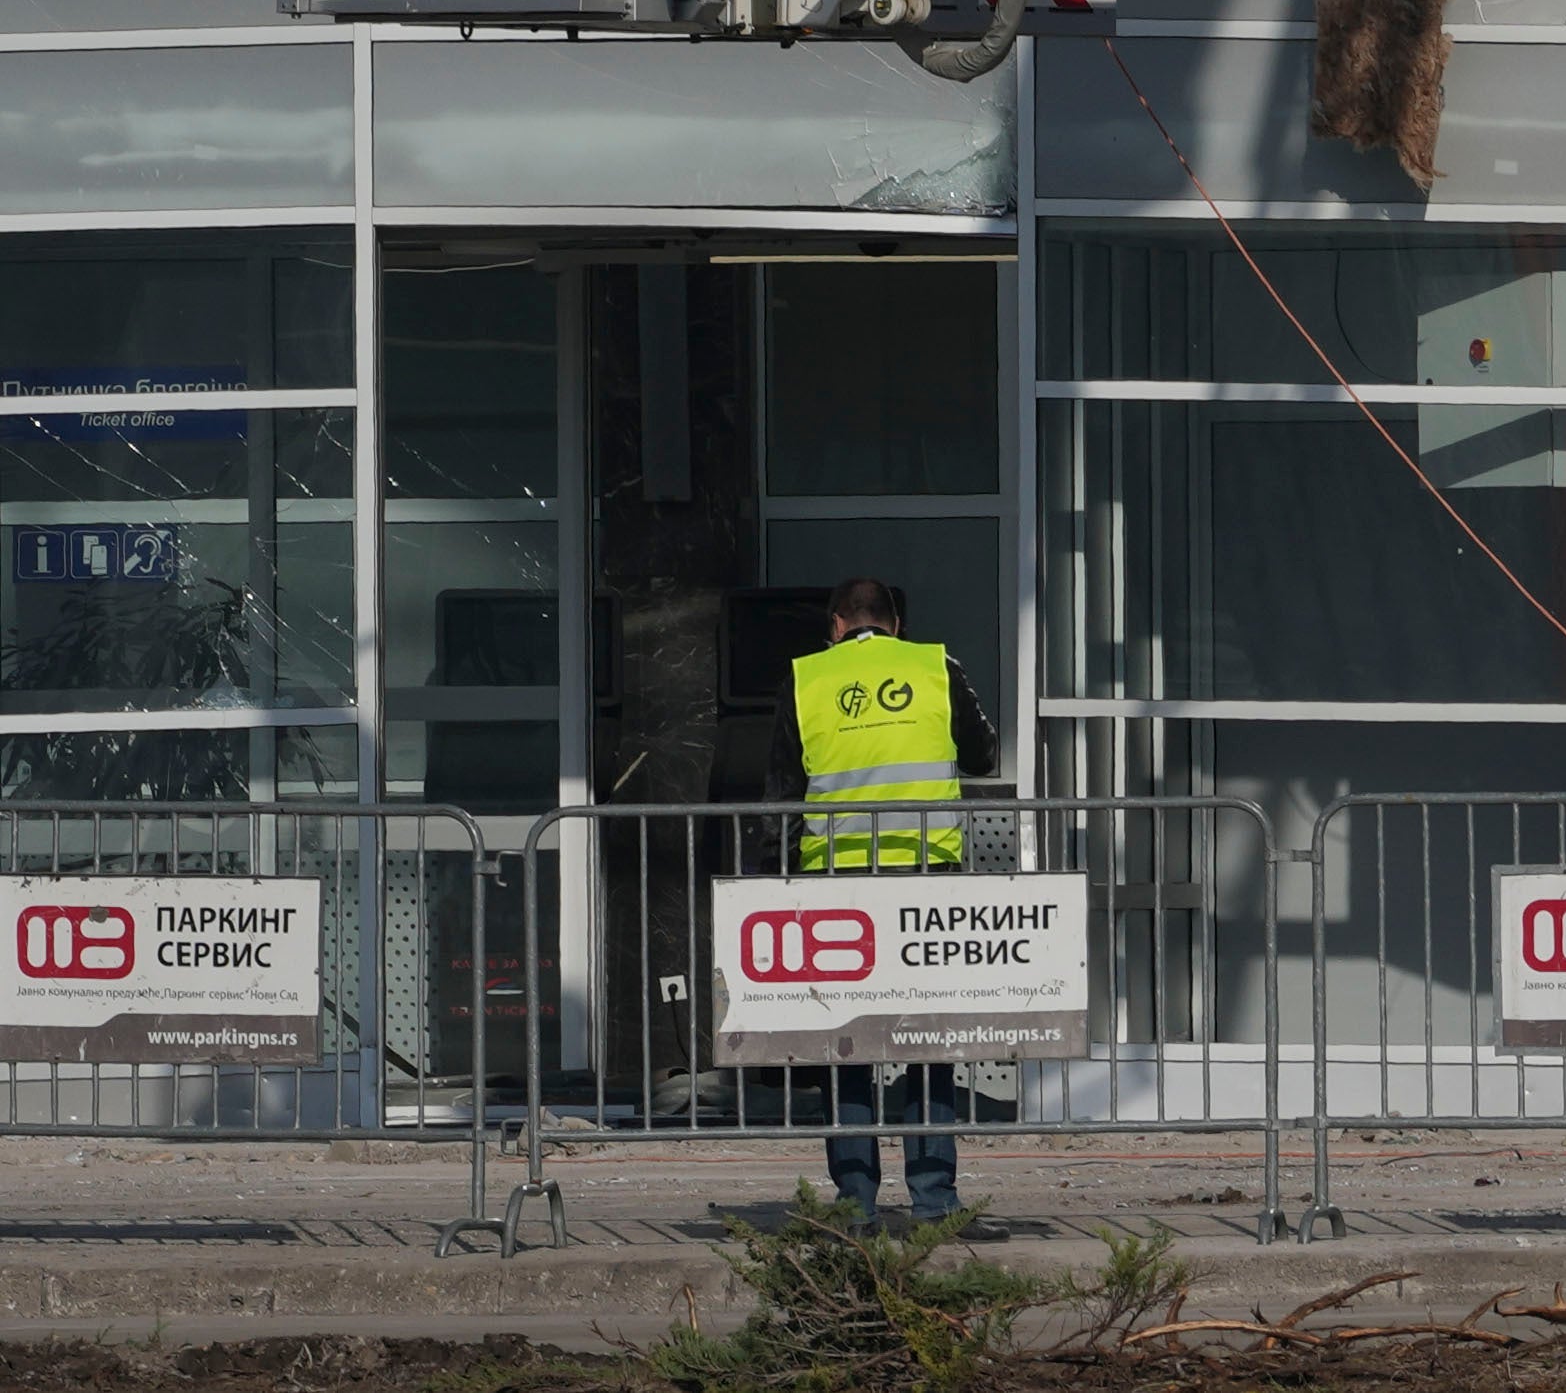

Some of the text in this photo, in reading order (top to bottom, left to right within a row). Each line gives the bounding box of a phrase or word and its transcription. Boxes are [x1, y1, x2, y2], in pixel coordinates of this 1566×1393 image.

[131, 412, 176, 427] office
[156, 906, 297, 933] ПАРКИНГ
[899, 904, 1058, 933] ПАРКИНГ
[158, 941, 272, 968] СЕРВИС
[901, 939, 1031, 967] СЕРВИС
[17, 986, 46, 998] Јавно
[48, 988, 103, 999] комунално
[106, 986, 160, 1001] предузеће
[250, 989, 276, 1000] Нови
[280, 990, 298, 1002] Сад
[742, 991, 774, 1002] Јавно
[844, 988, 905, 1001] предузеће
[1008, 985, 1038, 997] Нови
[1041, 984, 1061, 997] Сад
[1522, 979, 1554, 990] Јавно
[148, 1027, 298, 1049] www.parkingns.rs
[892, 1025, 1061, 1048] www.parkingns.rs
